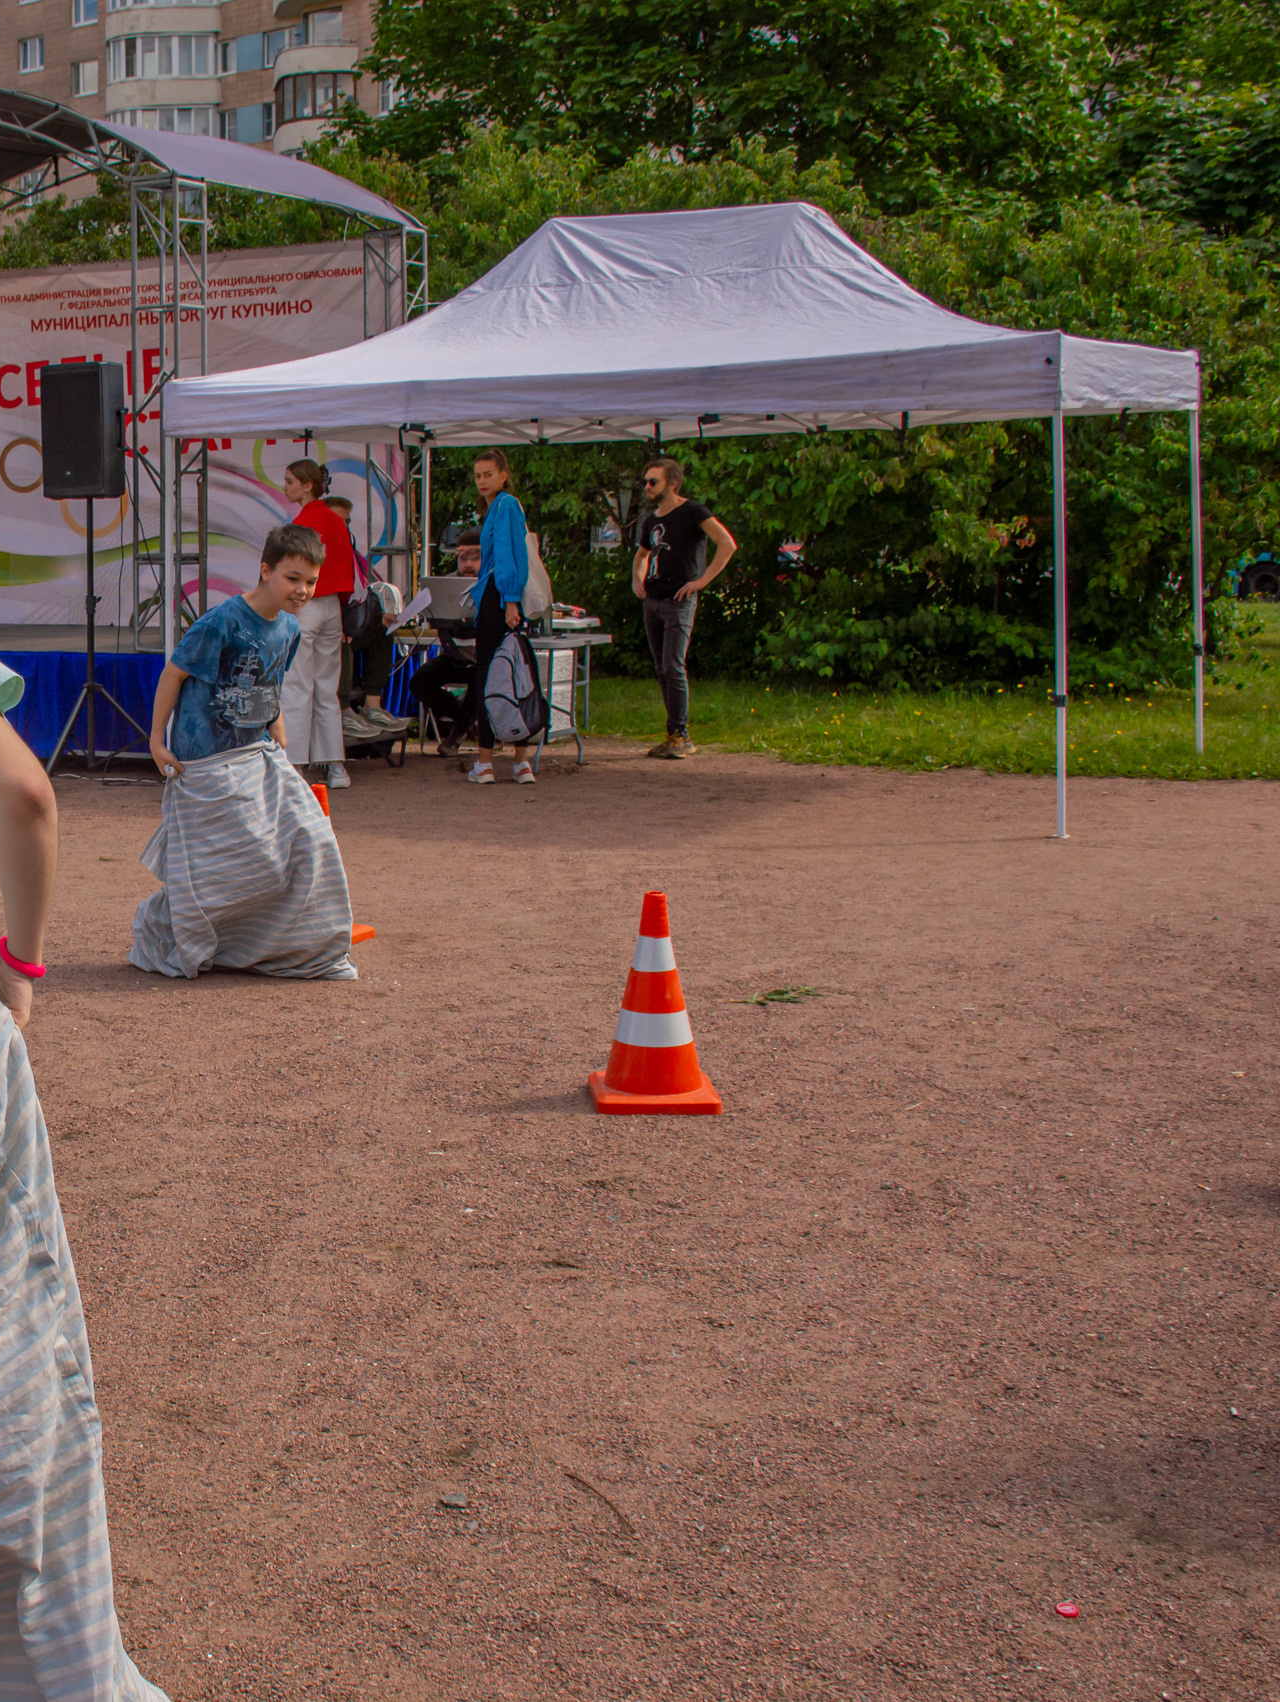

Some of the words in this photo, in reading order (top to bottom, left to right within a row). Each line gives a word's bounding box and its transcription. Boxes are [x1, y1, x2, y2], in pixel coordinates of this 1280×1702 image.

[22, 288, 102, 303] АДМИНИСТРАЦИЯ
[103, 280, 198, 297] ВНУТРГОРОСОГО
[200, 273, 294, 290] УНИЦИПАЛЬНОГО
[295, 266, 365, 281] ОБРАЗОВАНИ
[68, 297, 136, 310] ФЕДЕРАЛЬНОГ
[187, 286, 278, 302] САКТ-ПЕТЕРБУРГА
[179, 305, 228, 323] ОКУГ
[231, 299, 313, 320] КУПЧИНО
